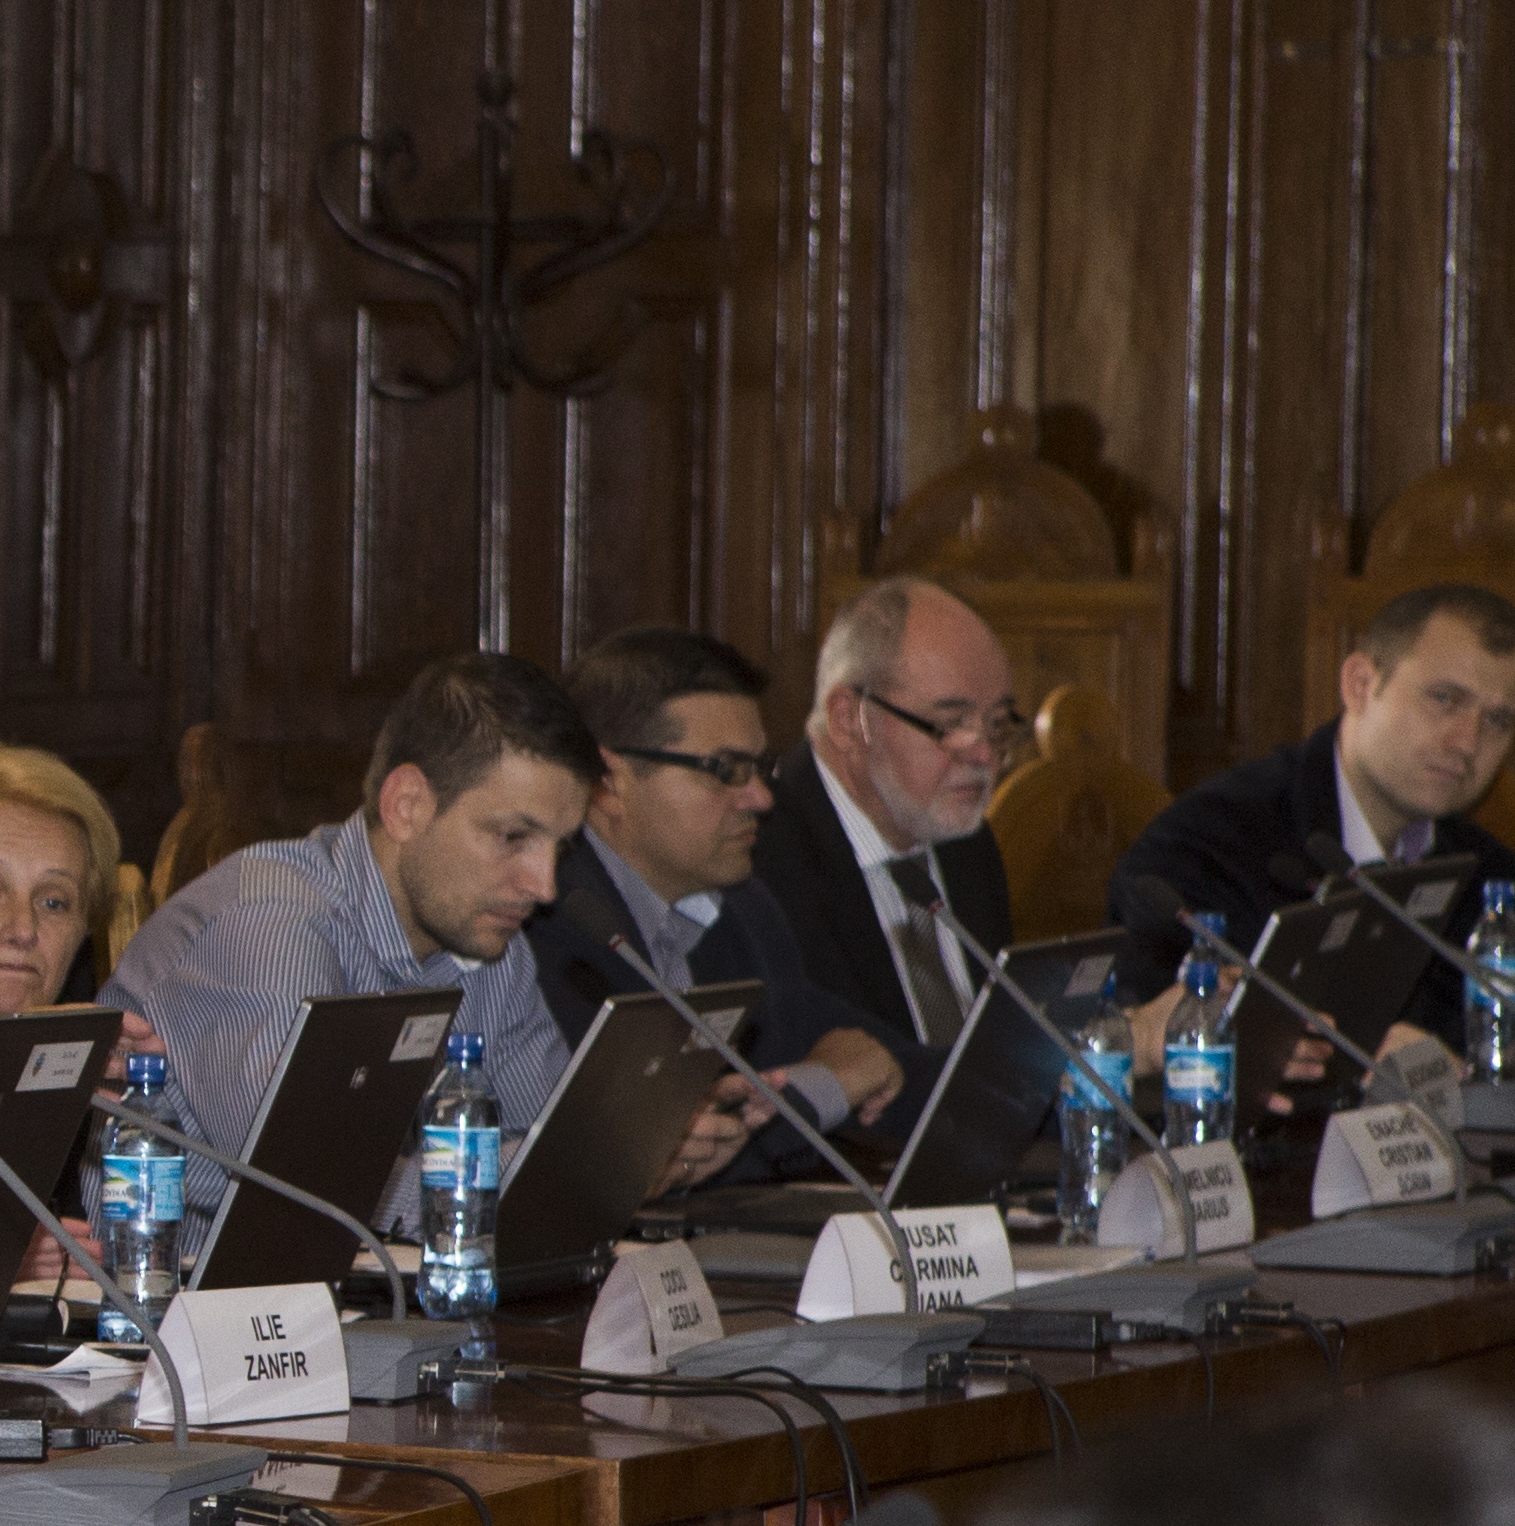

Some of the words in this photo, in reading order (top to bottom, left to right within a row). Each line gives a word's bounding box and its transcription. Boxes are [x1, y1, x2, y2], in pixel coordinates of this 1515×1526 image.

[1191, 1196, 1229, 1221] ARIUS
[900, 1222, 958, 1249] USAT
[889, 1254, 979, 1282] CRMINA
[920, 1289, 964, 1313] IANA
[250, 1314, 287, 1342] ILIE
[244, 1350, 310, 1382] ZANFIR
